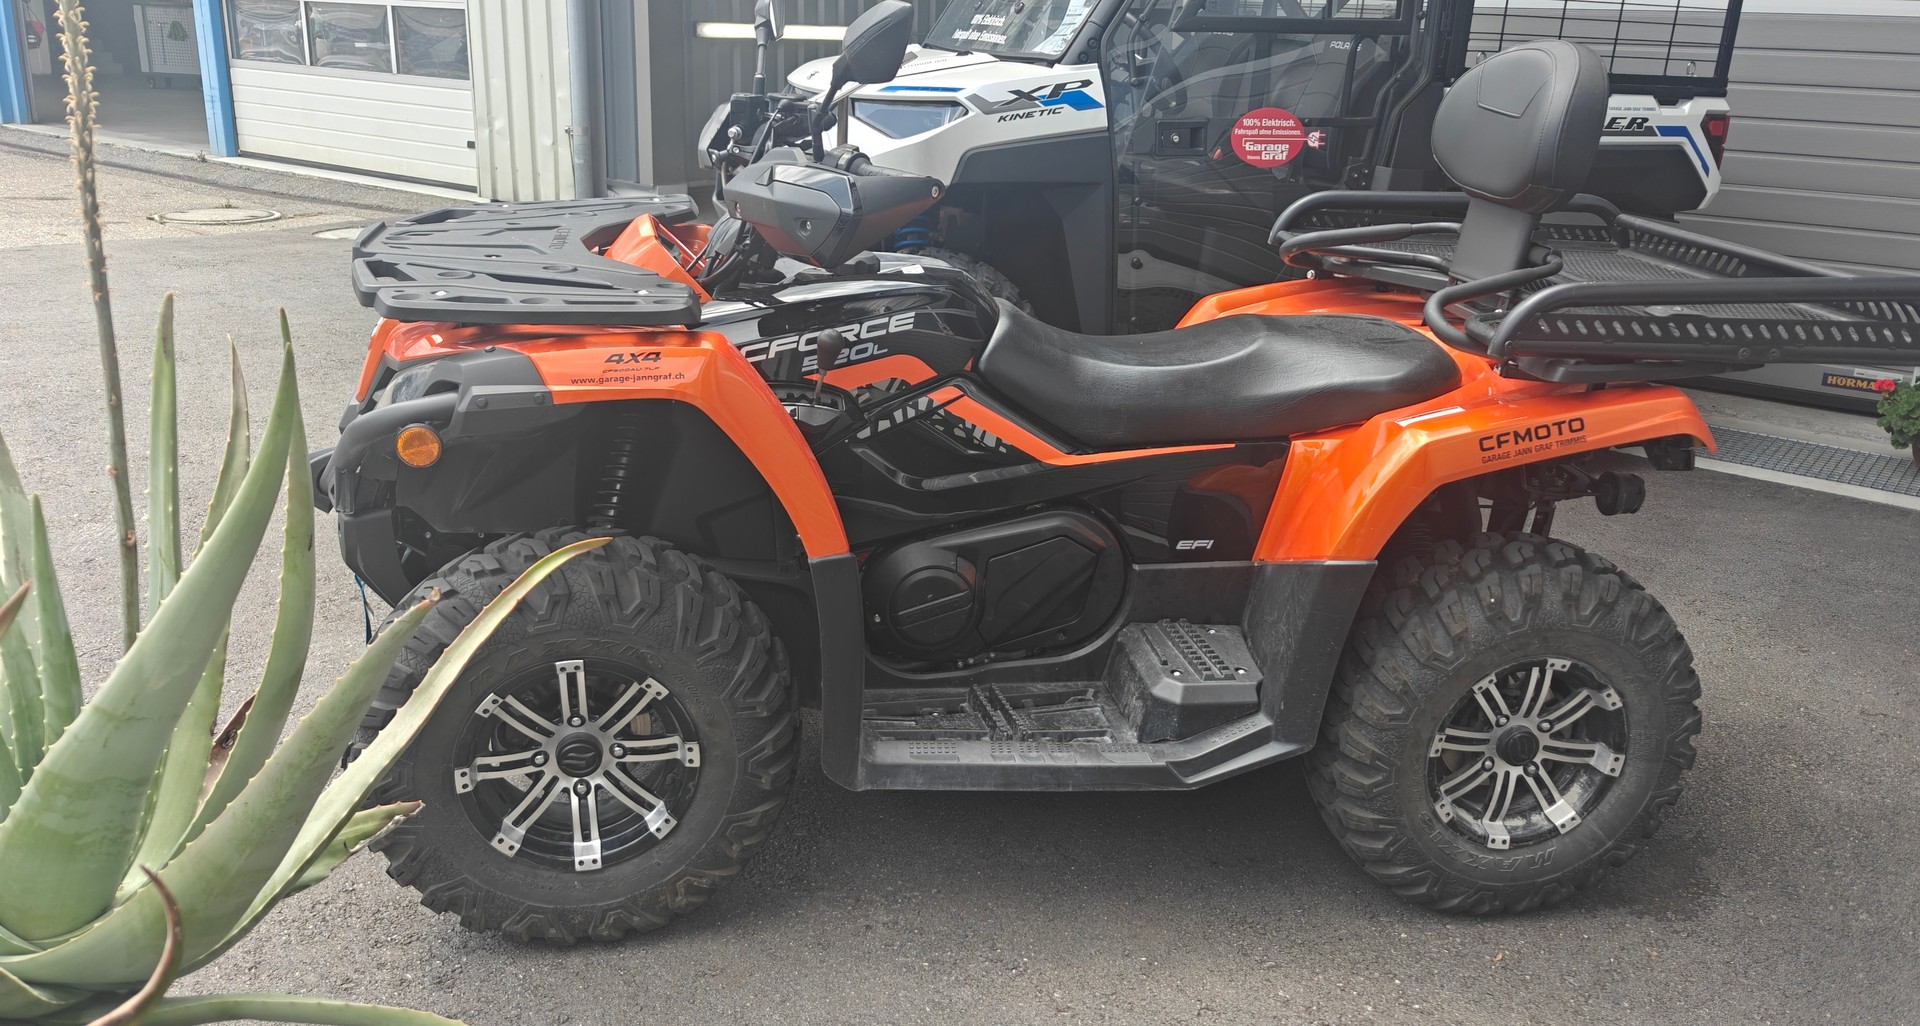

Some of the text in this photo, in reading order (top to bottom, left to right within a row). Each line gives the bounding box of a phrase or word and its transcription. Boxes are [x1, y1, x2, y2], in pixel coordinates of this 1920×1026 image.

[998, 79, 1094, 107] XP
[997, 106, 1064, 123] KINETIC
[1242, 118, 1296, 127] 100% Elektrisch.
[1245, 142, 1290, 153] Garage
[1261, 151, 1288, 160] Graf
[571, 371, 685, 385] www.garage-janngraf.ch
[1478, 417, 1585, 452] CFMOTO
[1481, 450, 1512, 464] GARAGE
[1513, 446, 1533, 458] JANN
[1534, 441, 1553, 453] GRAF
[1175, 539, 1215, 550] EFI
